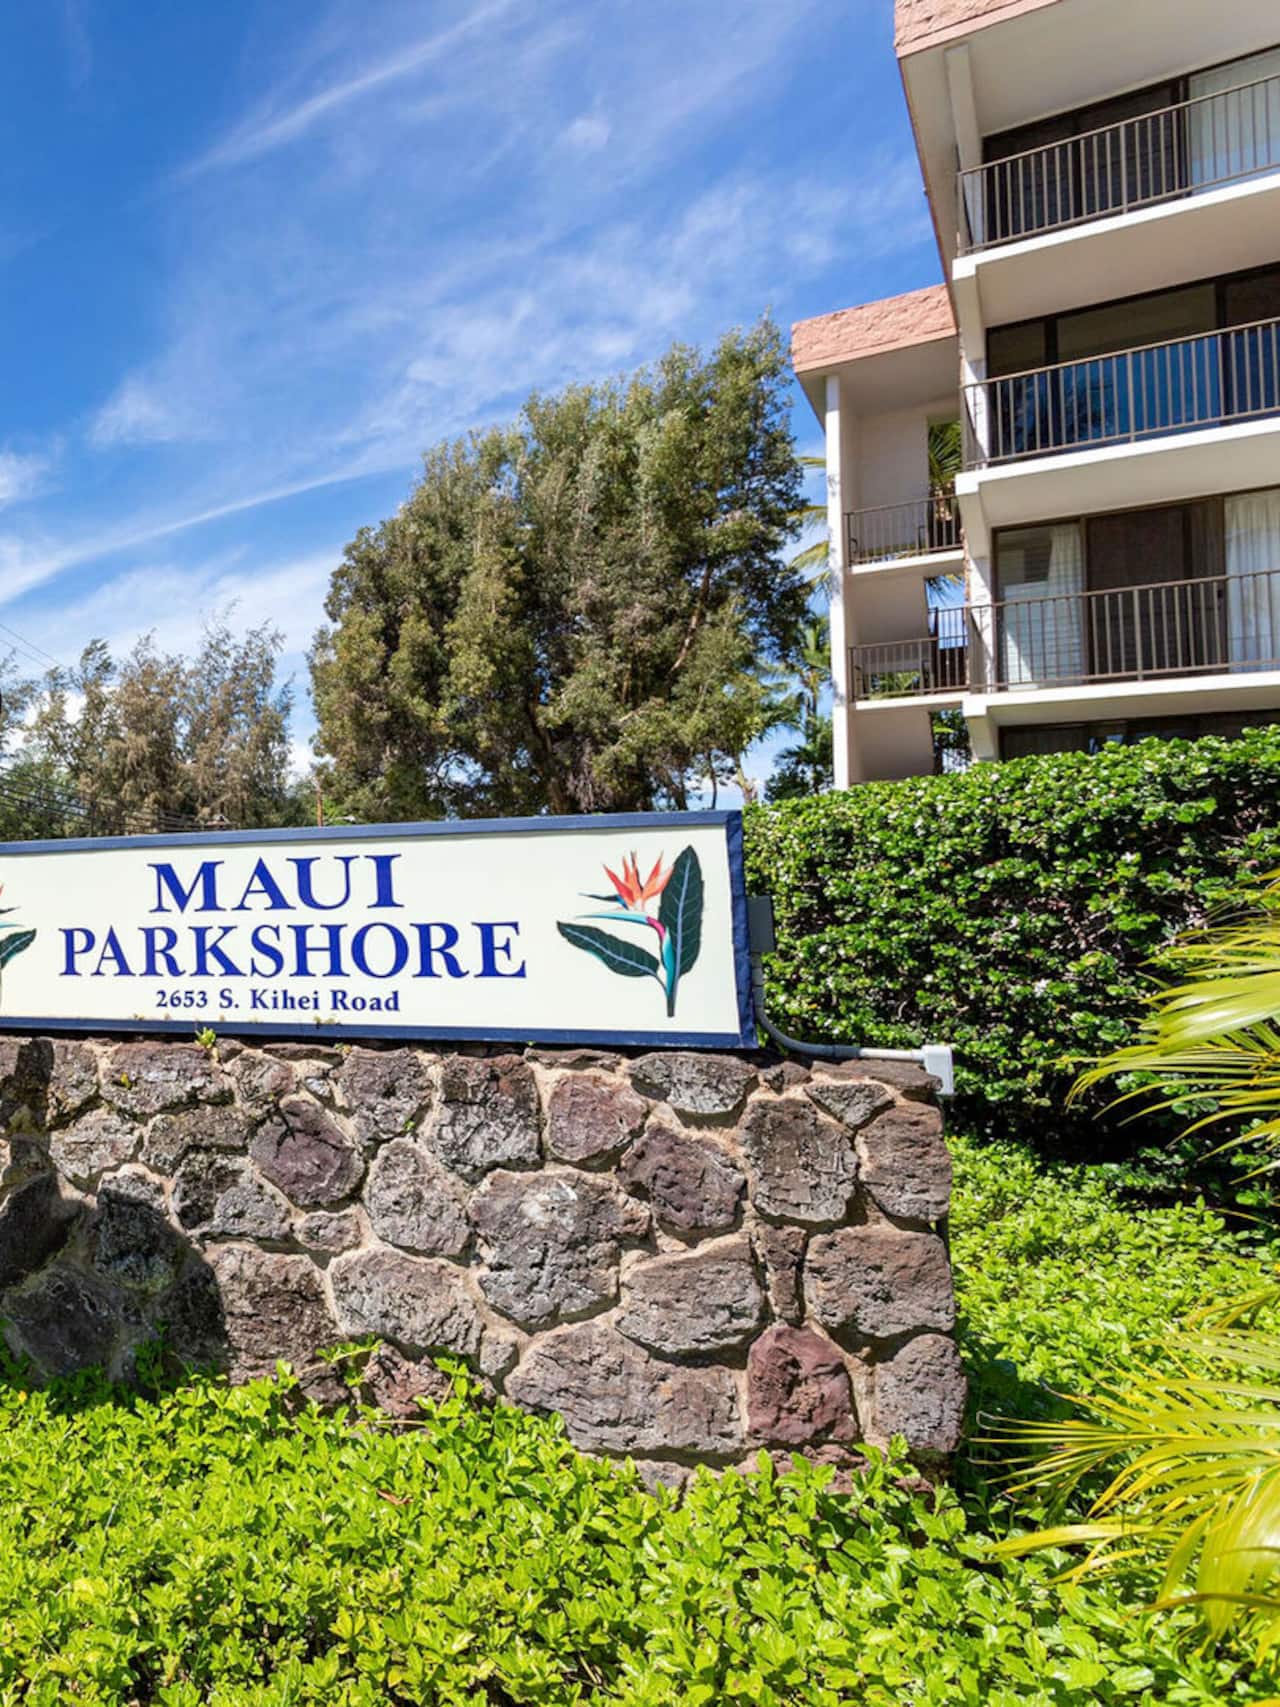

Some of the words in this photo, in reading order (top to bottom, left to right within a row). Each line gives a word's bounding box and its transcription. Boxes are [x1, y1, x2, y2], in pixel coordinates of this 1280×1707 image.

[147, 853, 405, 914] MAUI
[58, 920, 528, 980] PARKSHORE
[155, 989, 209, 1010] 2653
[219, 989, 240, 1010] S.
[250, 989, 320, 1012] Kihei
[330, 989, 401, 1013] Road
